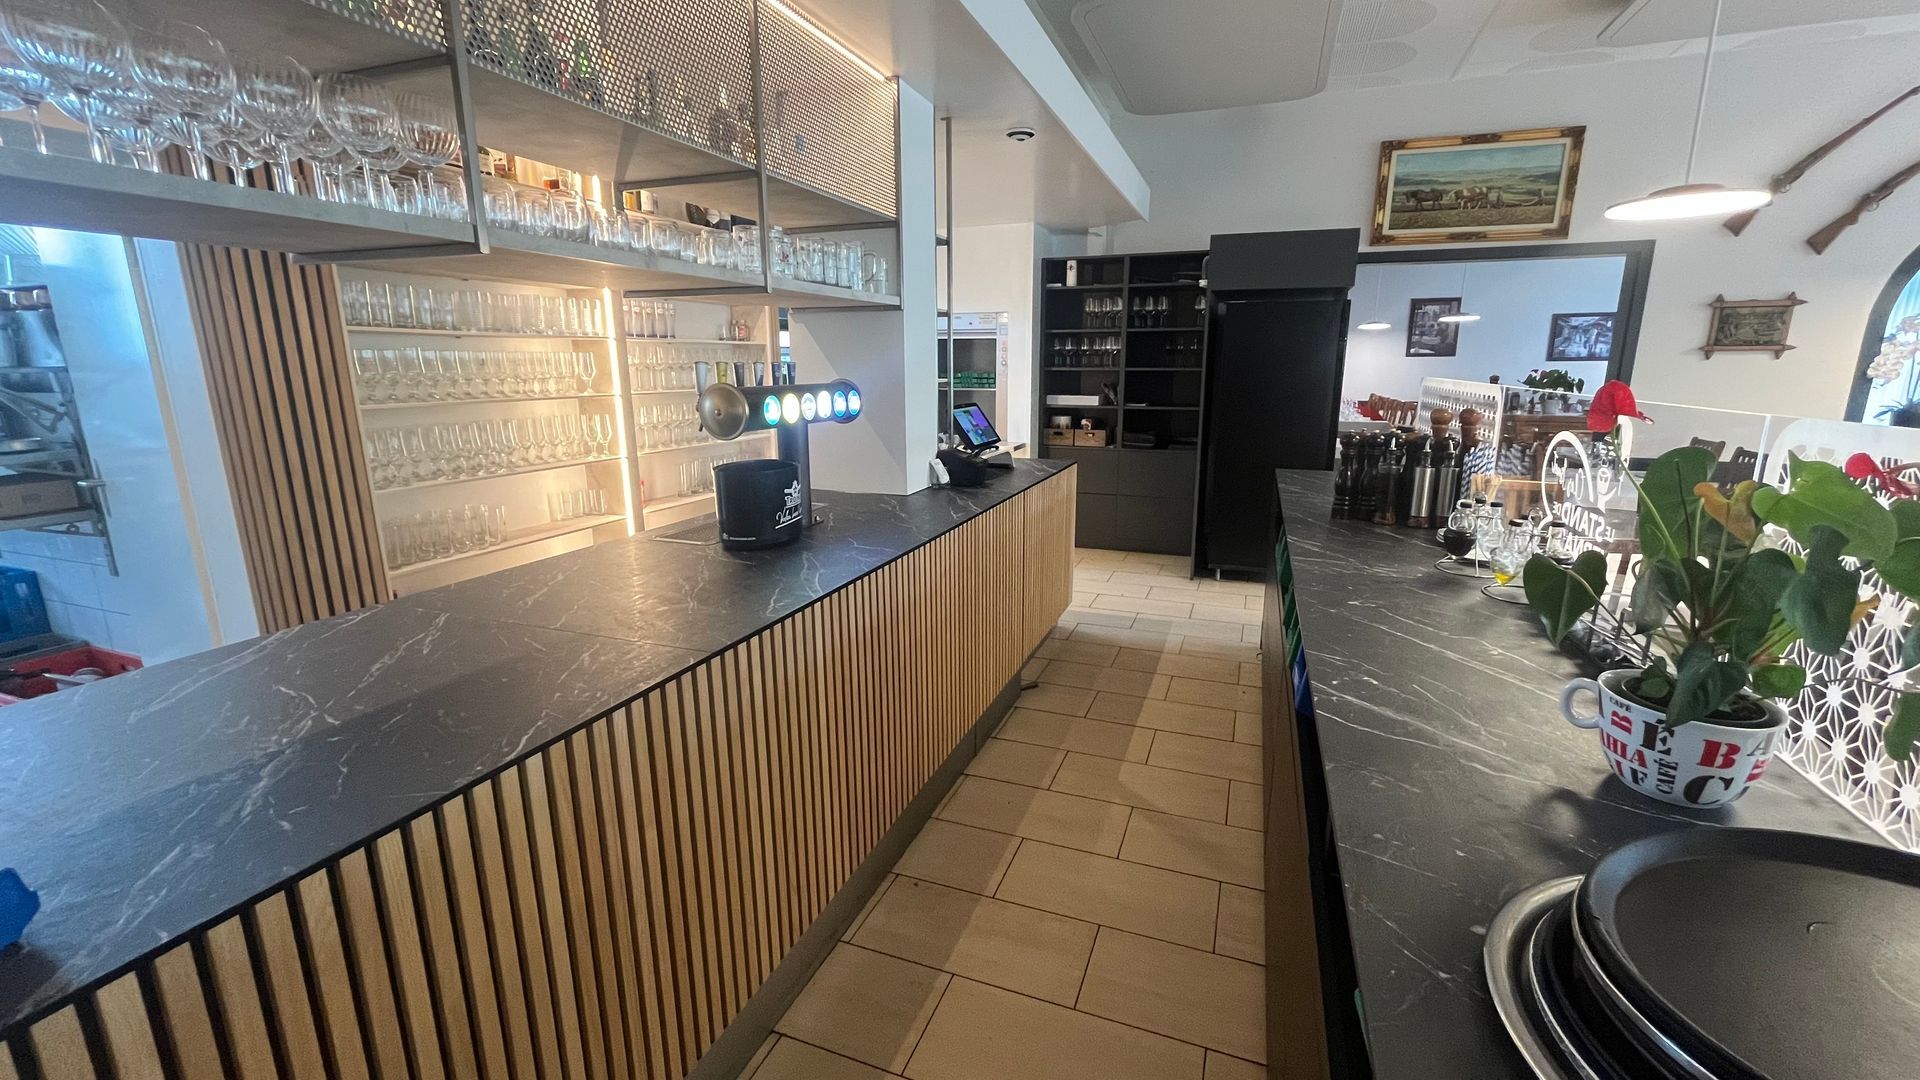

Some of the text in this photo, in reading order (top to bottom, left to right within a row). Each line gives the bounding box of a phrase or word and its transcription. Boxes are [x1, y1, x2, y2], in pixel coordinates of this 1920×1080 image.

[1696, 738, 1741, 769] B
[1653, 757, 1679, 795] CAFÉ
[1683, 775, 1735, 804] C
